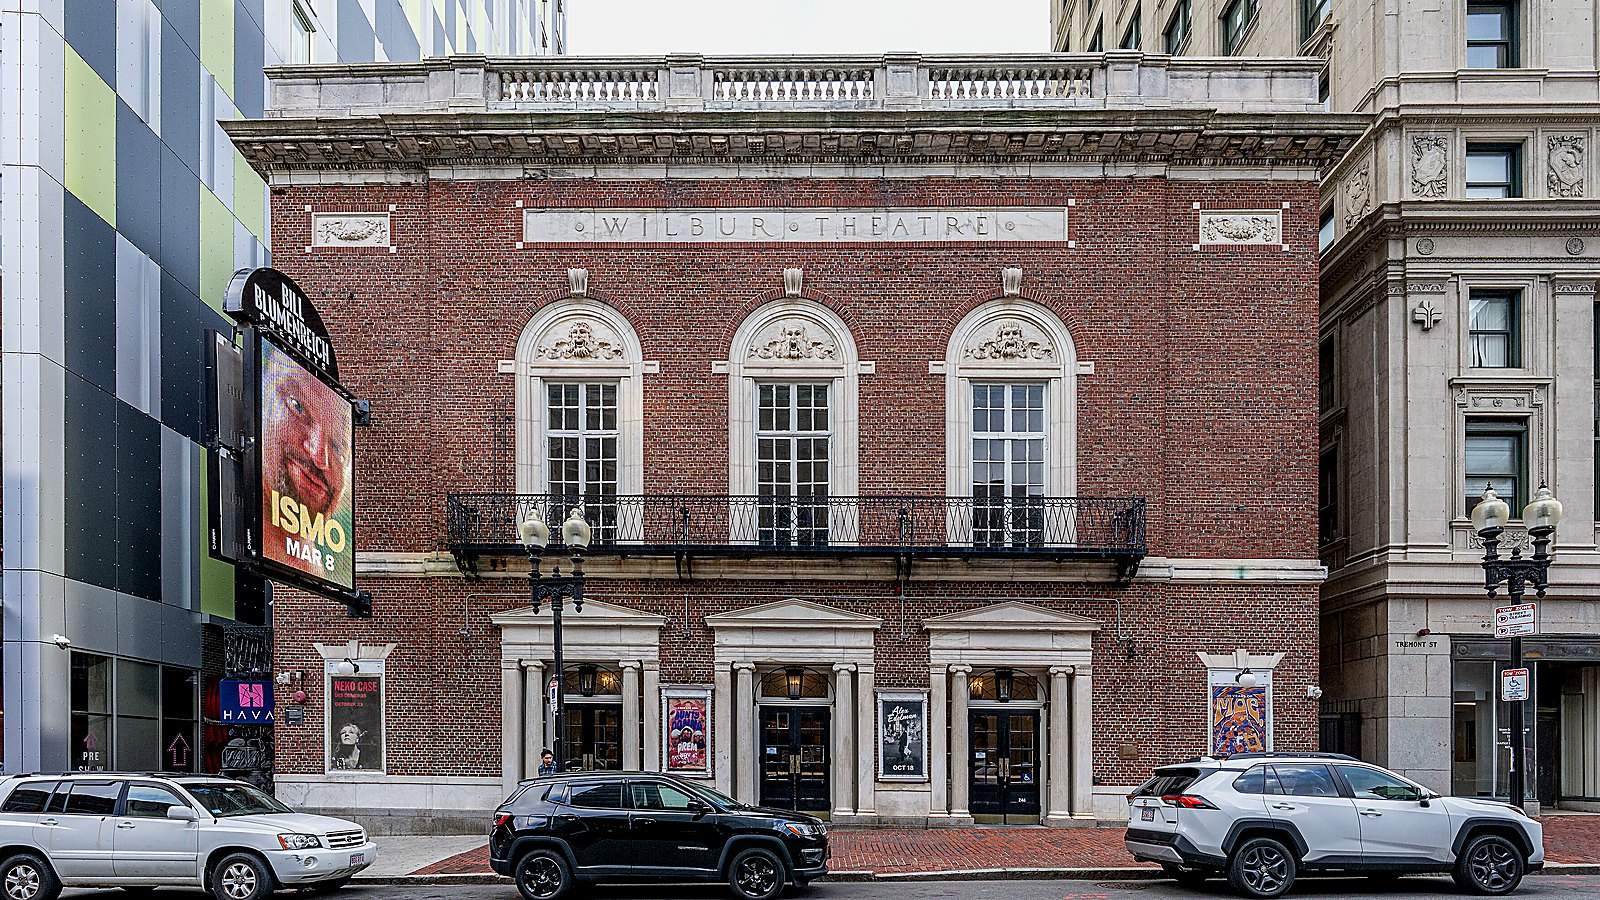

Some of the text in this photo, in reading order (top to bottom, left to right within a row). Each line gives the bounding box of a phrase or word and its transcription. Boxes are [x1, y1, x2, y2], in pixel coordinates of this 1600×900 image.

[602, 216, 988, 237] WILBUR THEATRE
[281, 282, 305, 322] BILL
[254, 282, 330, 366] BLUMENREICH
[259, 312, 327, 371] PRESENTS
[271, 489, 346, 553] ISMO
[285, 536, 335, 572] MAR 8
[334, 681, 378, 692] NEKO CASE
[887, 712, 918, 723] Edelman
[892, 705, 910, 714] Alex
[82, 751, 100, 761] PRE
